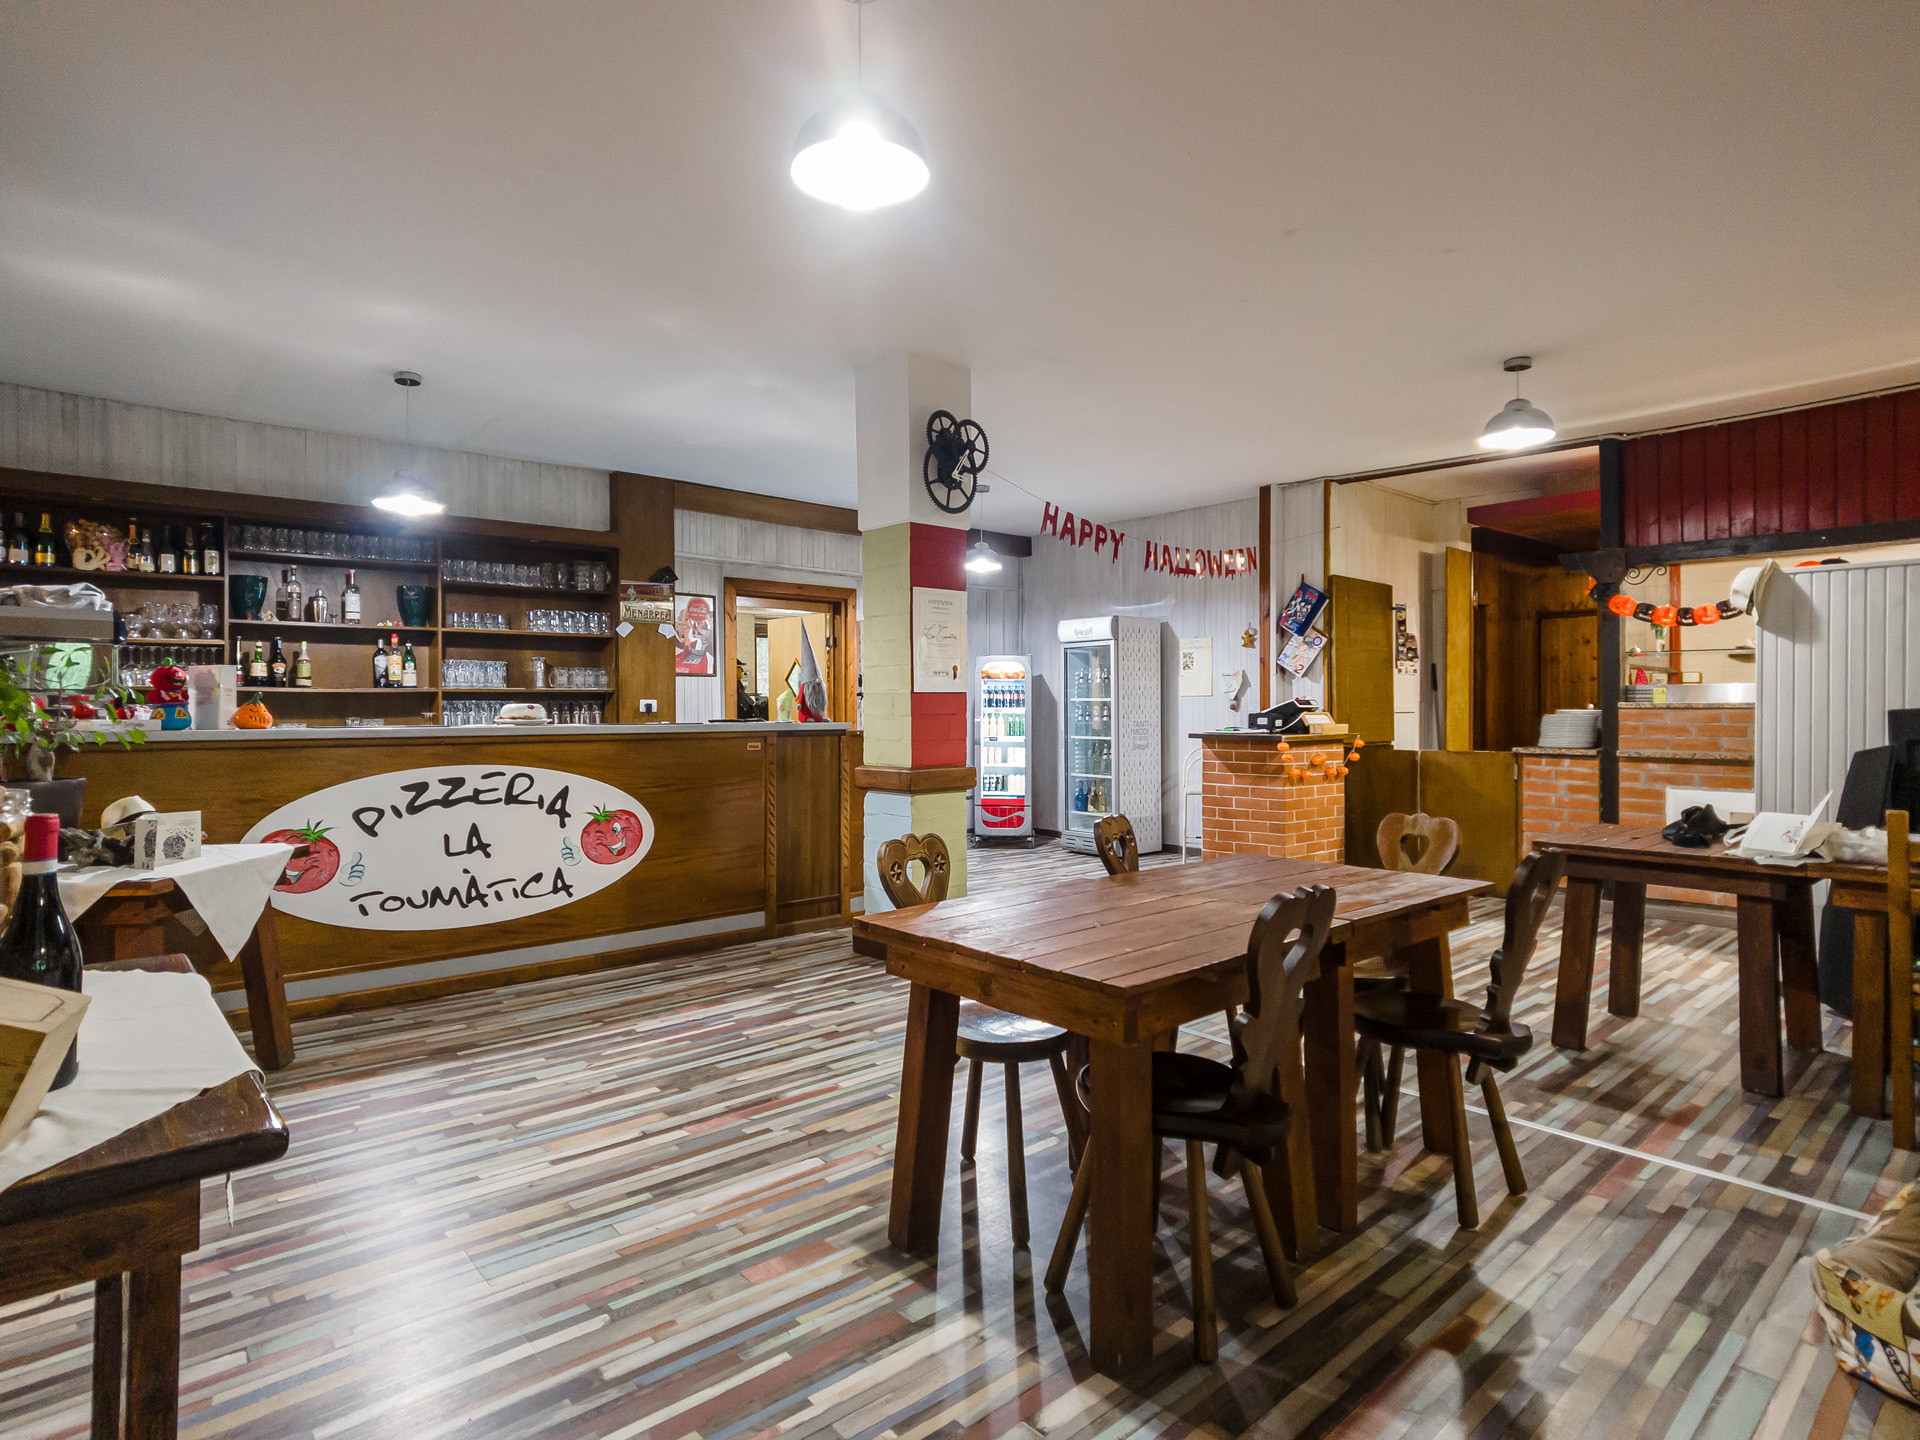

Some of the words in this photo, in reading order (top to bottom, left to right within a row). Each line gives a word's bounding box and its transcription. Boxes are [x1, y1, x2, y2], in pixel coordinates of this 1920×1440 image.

[1040, 501, 1125, 564] HAPPY
[1144, 540, 1258, 580] HALLOWEEN
[624, 604, 672, 621] MENABREA
[352, 771, 571, 837] PIZZERIA
[443, 822, 492, 859] LA
[349, 867, 573, 916] TOUMÀTICA
